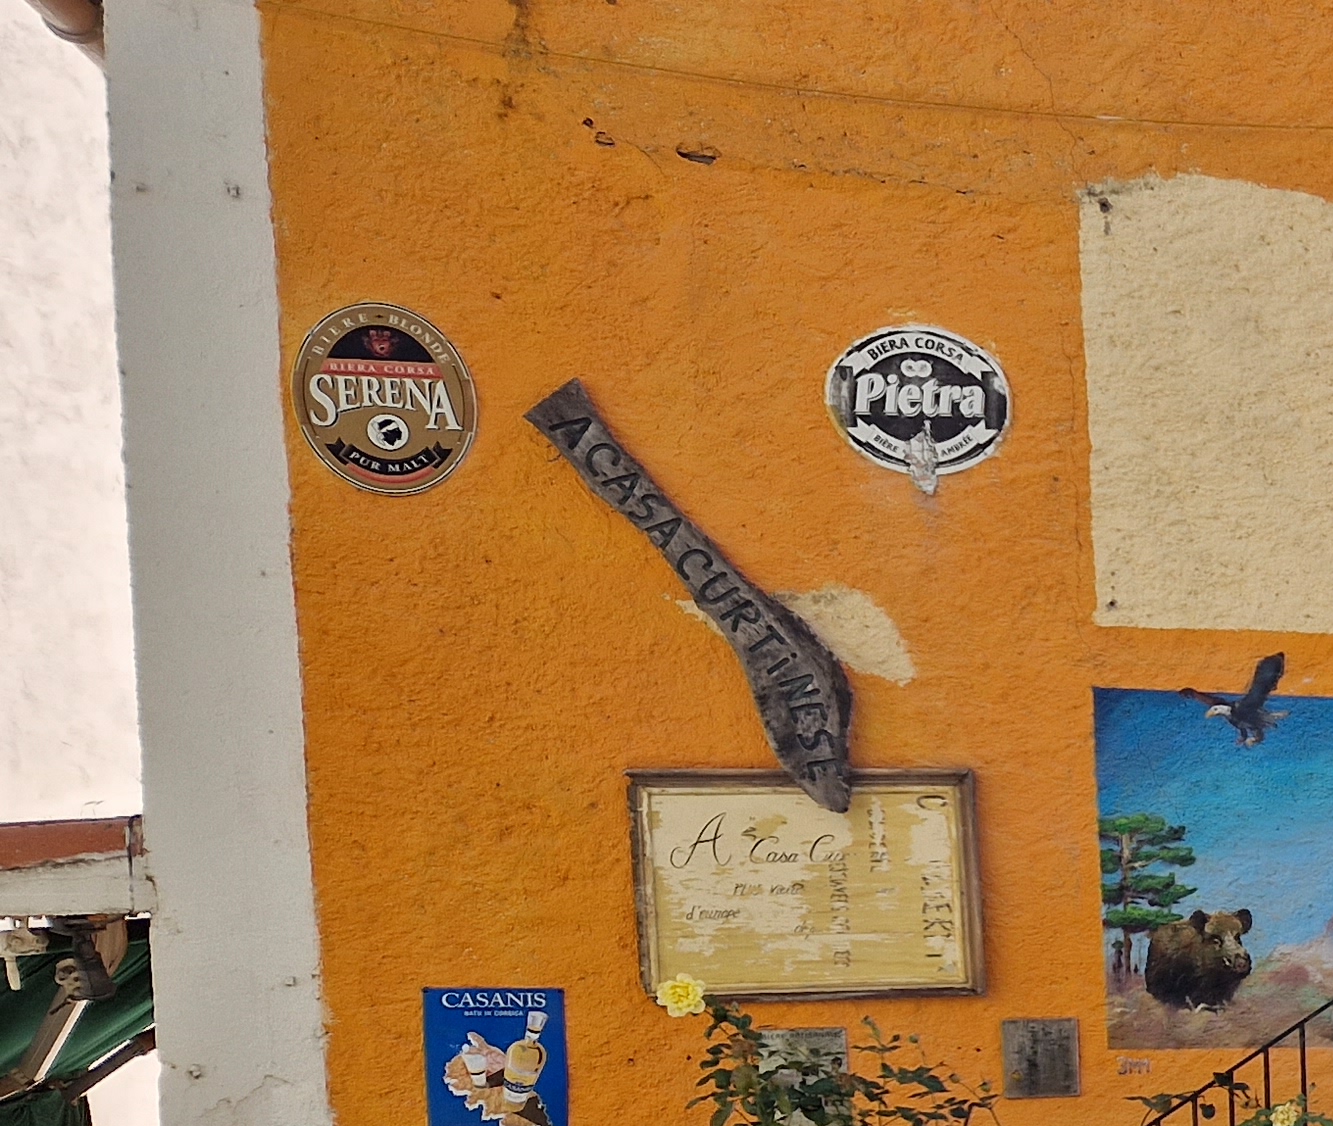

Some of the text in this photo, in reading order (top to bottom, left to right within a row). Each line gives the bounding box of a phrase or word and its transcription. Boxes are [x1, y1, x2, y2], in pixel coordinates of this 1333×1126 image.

[312, 313, 451, 364] BIERE BLONDE
[868, 337, 964, 363] BIERA CORSA
[329, 362, 436, 375] BIERA CORSA
[309, 373, 463, 430] SERENA
[855, 373, 987, 417] Pietra
[349, 451, 429, 472] PUR MALT
[549, 415, 593, 451] A
[585, 442, 683, 551] CASA
[670, 812, 732, 868] A
[750, 835, 800, 863] Casa
[441, 992, 546, 1008] CASANIS
